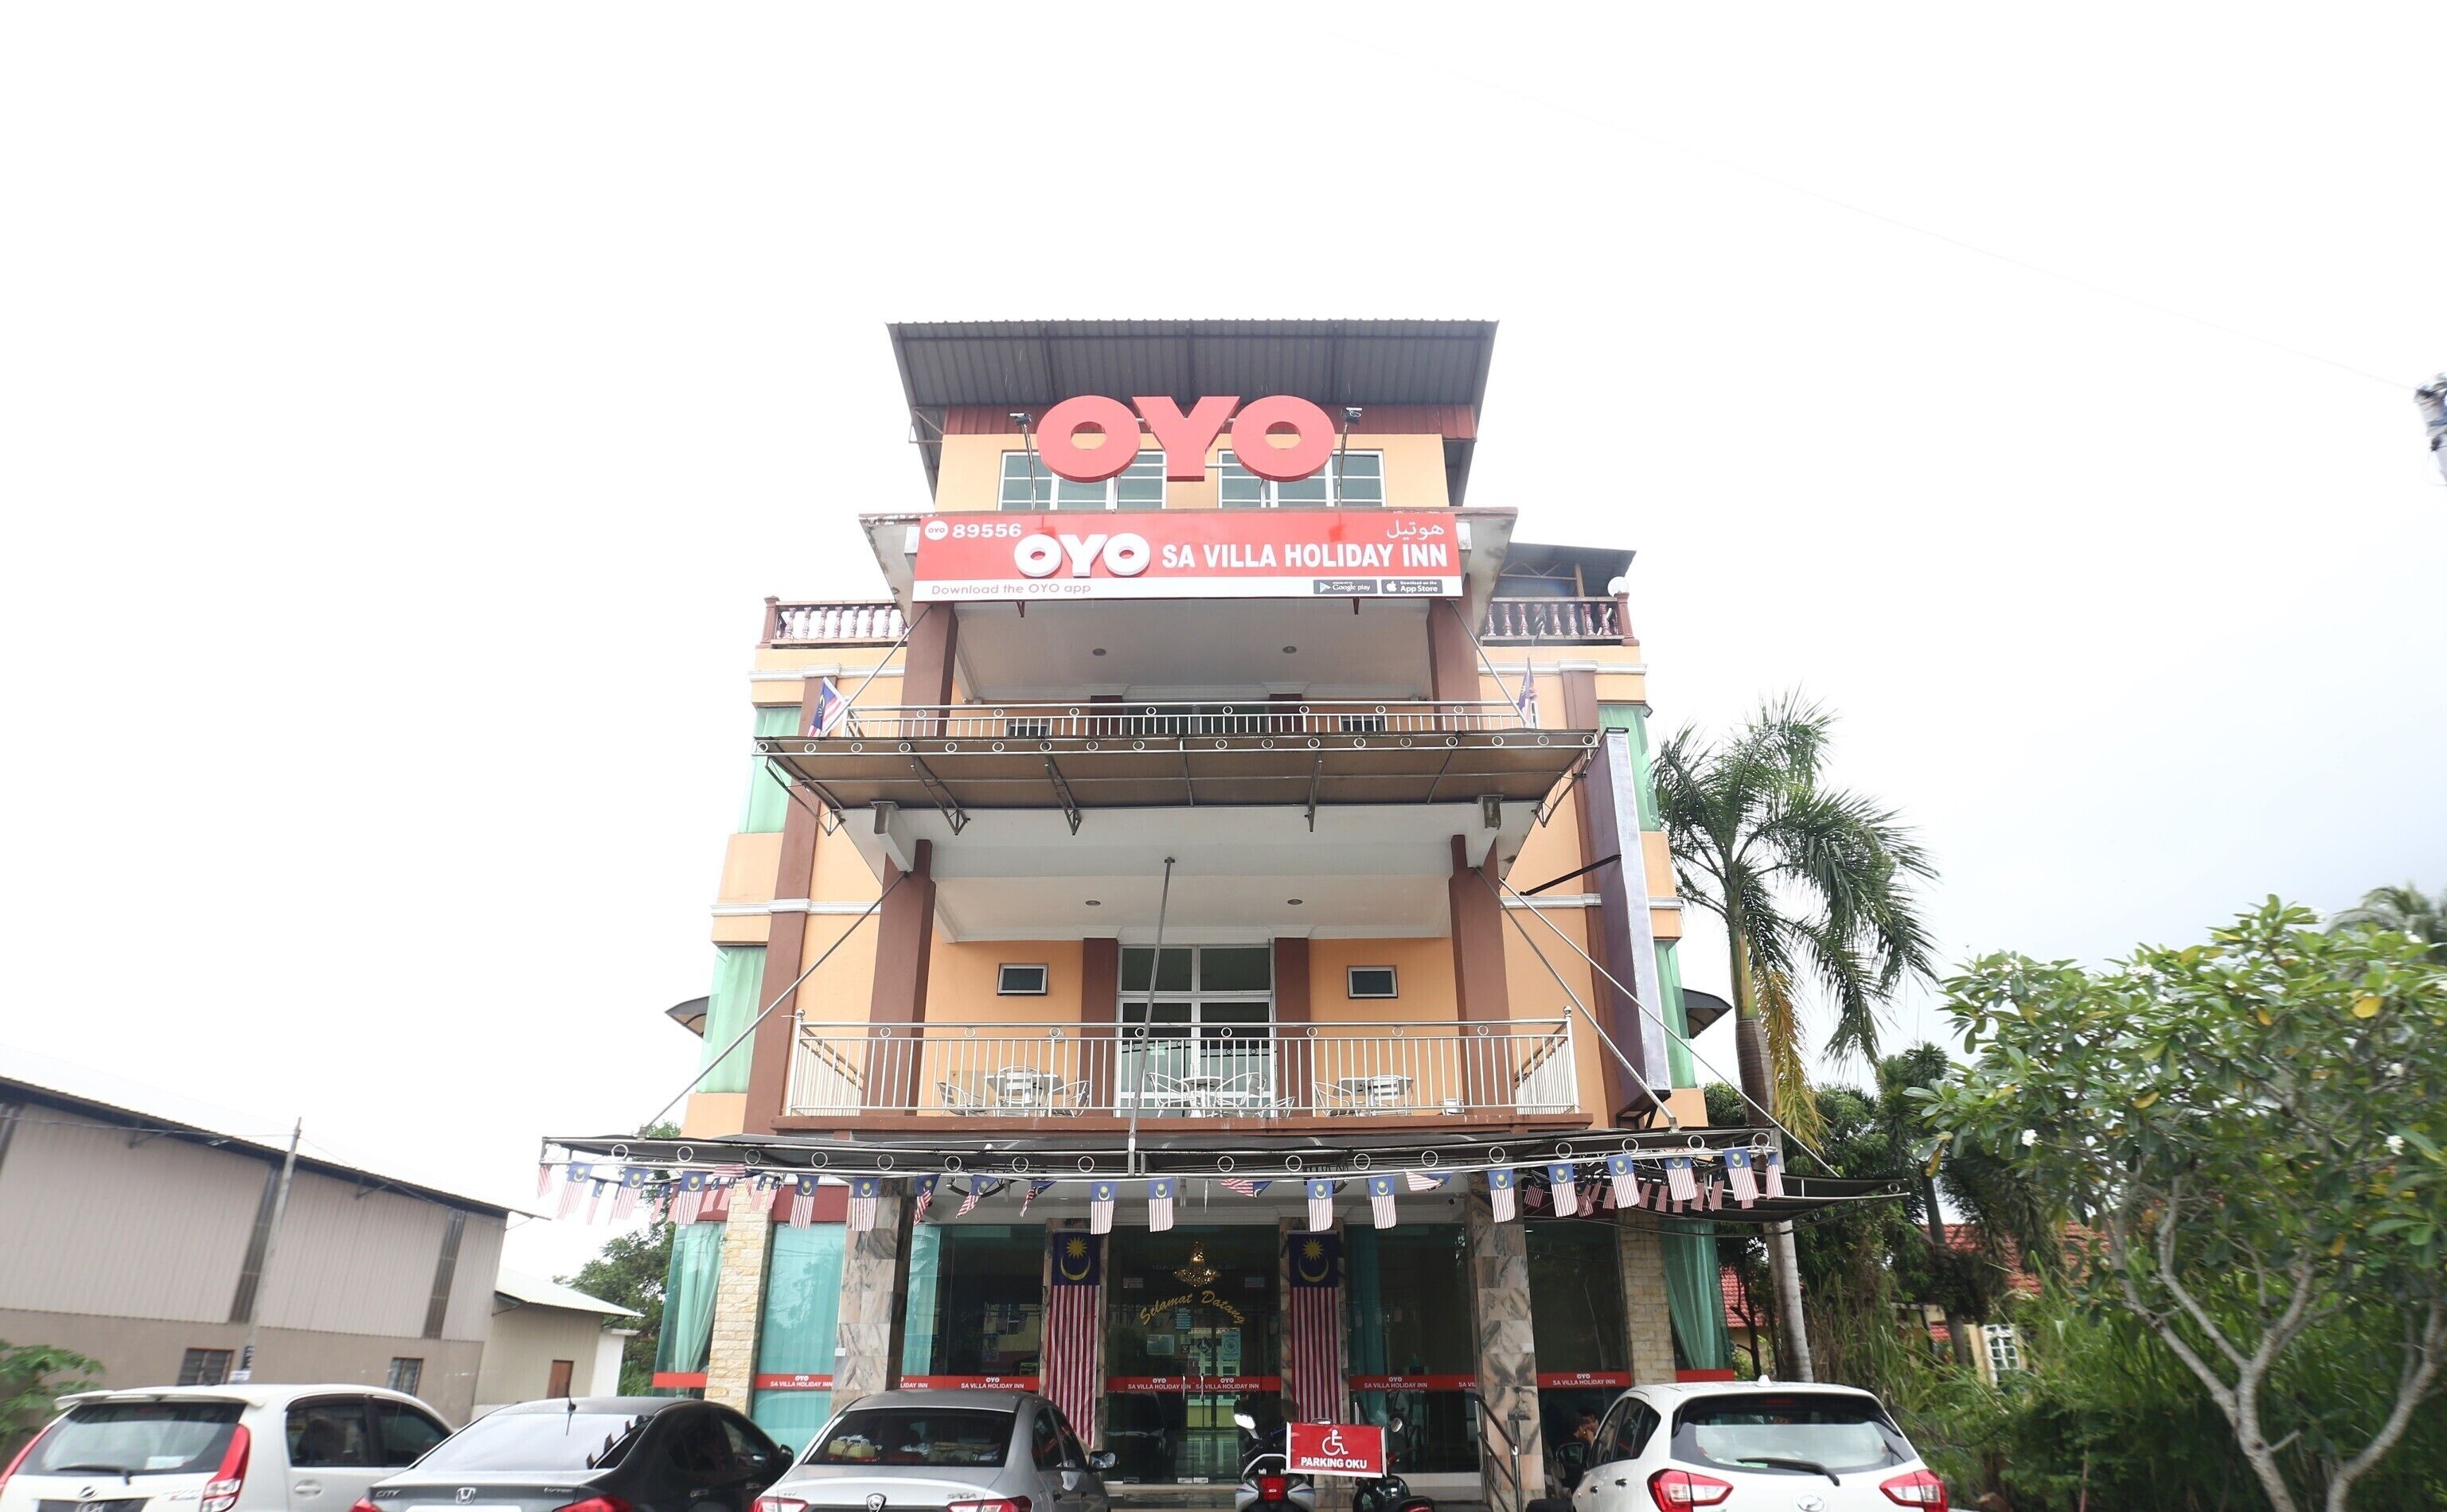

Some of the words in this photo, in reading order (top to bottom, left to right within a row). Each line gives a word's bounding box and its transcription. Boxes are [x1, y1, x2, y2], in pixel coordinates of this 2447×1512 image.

[1036, 395, 1335, 483] OYO
[952, 523, 1022, 539] 89556
[1387, 520, 1444, 541] هوتيل
[1014, 532, 1151, 579] OYO
[1161, 544, 1196, 568] SA
[1203, 544, 1277, 568] VILLA
[1285, 544, 1394, 567] HOLIDAY
[1403, 544, 1448, 567] INN
[932, 585, 998, 595] Download
[1004, 584, 1024, 594] the
[1028, 583, 1060, 594] OYO
[1064, 585, 1091, 594] app
[1400, 585, 1417, 594] App
[1140, 1292, 1193, 1325] Selamat
[1201, 1290, 1245, 1325] Datang
[1301, 1456, 1344, 1468] PARKING
[1345, 1459, 1368, 1469] OKU
